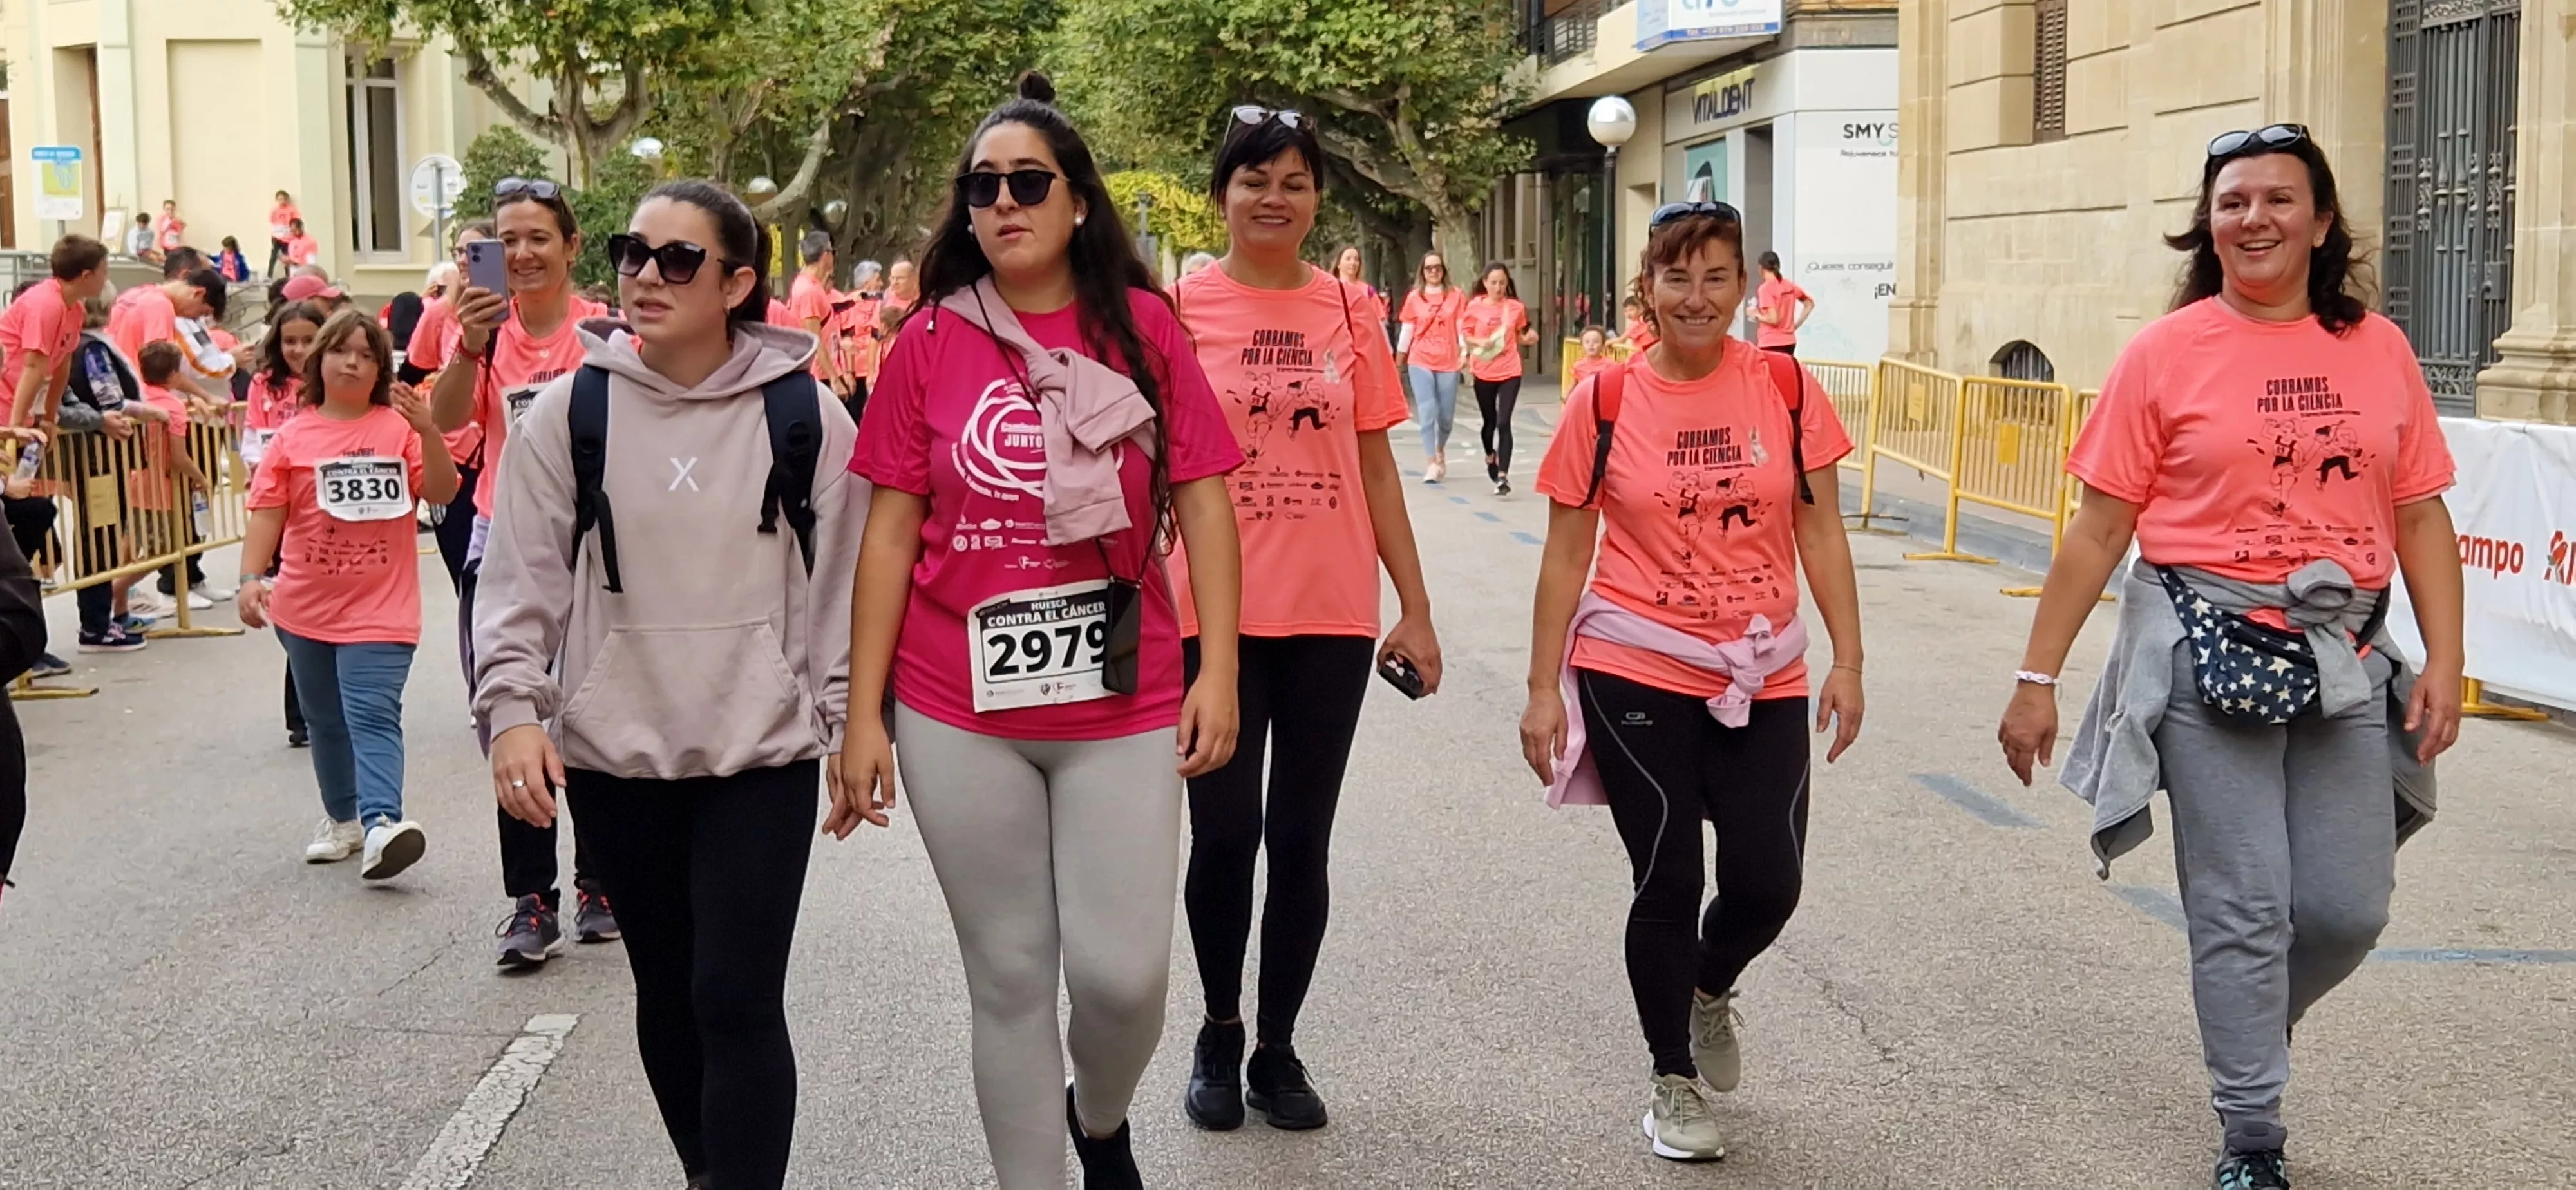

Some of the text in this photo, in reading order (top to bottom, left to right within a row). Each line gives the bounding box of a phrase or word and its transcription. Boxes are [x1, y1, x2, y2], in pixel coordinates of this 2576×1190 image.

[1691, 77, 1755, 125] VITALDENT
[1842, 123, 1884, 139] SMY
[1848, 260, 1894, 272] conseguir
[1252, 329, 1305, 348] CORRAMOS
[1240, 348, 1313, 366] POR LA CIENCIA
[2266, 376, 2329, 396] CORRAMOS
[2257, 393, 2343, 413] POR LA CIENCIA
[1004, 433, 1043, 449] JUNTO
[1676, 426, 1731, 450] CORRAMOS
[1666, 450, 1687, 467] POR
[1689, 448, 1700, 466] LA
[1703, 445, 1742, 466] CIENCIA
[668, 457, 700, 492] X
[327, 477, 401, 504] 3830
[2459, 534, 2524, 580] ampo
[987, 601, 1106, 628] CONTRA EL CÁNCER
[1030, 599, 1068, 612] HUESCA
[987, 620, 1107, 677] 2979
